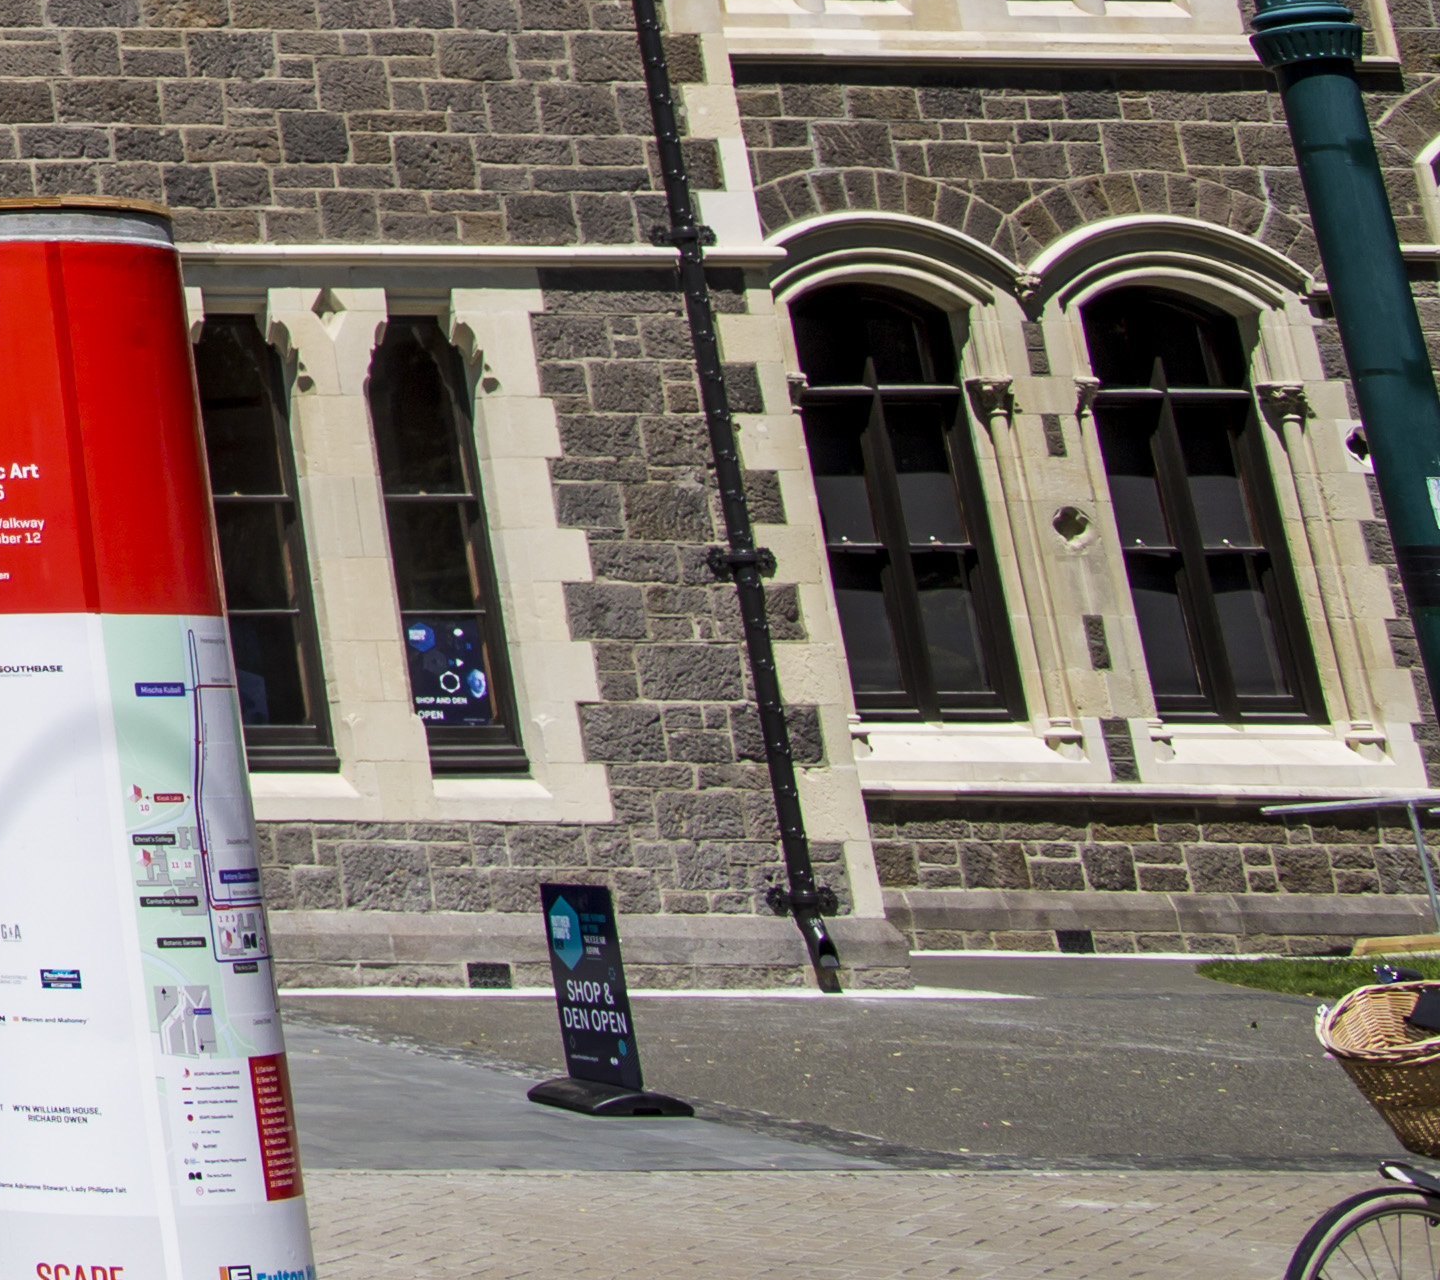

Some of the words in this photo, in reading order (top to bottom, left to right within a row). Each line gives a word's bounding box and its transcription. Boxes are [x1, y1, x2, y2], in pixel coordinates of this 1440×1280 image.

[10, 463, 40, 479] Art
[25, 532, 41, 544] 12
[415, 696, 435, 704] SHOP
[418, 710, 444, 720] OPEN
[566, 979, 601, 1003] SHOP
[604, 982, 615, 1005] &
[58, 1017, 88, 1025] Mahoney
[563, 1006, 590, 1030] DEN
[591, 1009, 628, 1034] OPEN
[12, 1104, 31, 1113] WYN
[32, 1105, 71, 1114] WILLIAMS
[72, 1107, 102, 1116] HOUSE,
[27, 1114, 63, 1123] RICHARD
[64, 1115, 88, 1124] OWEN
